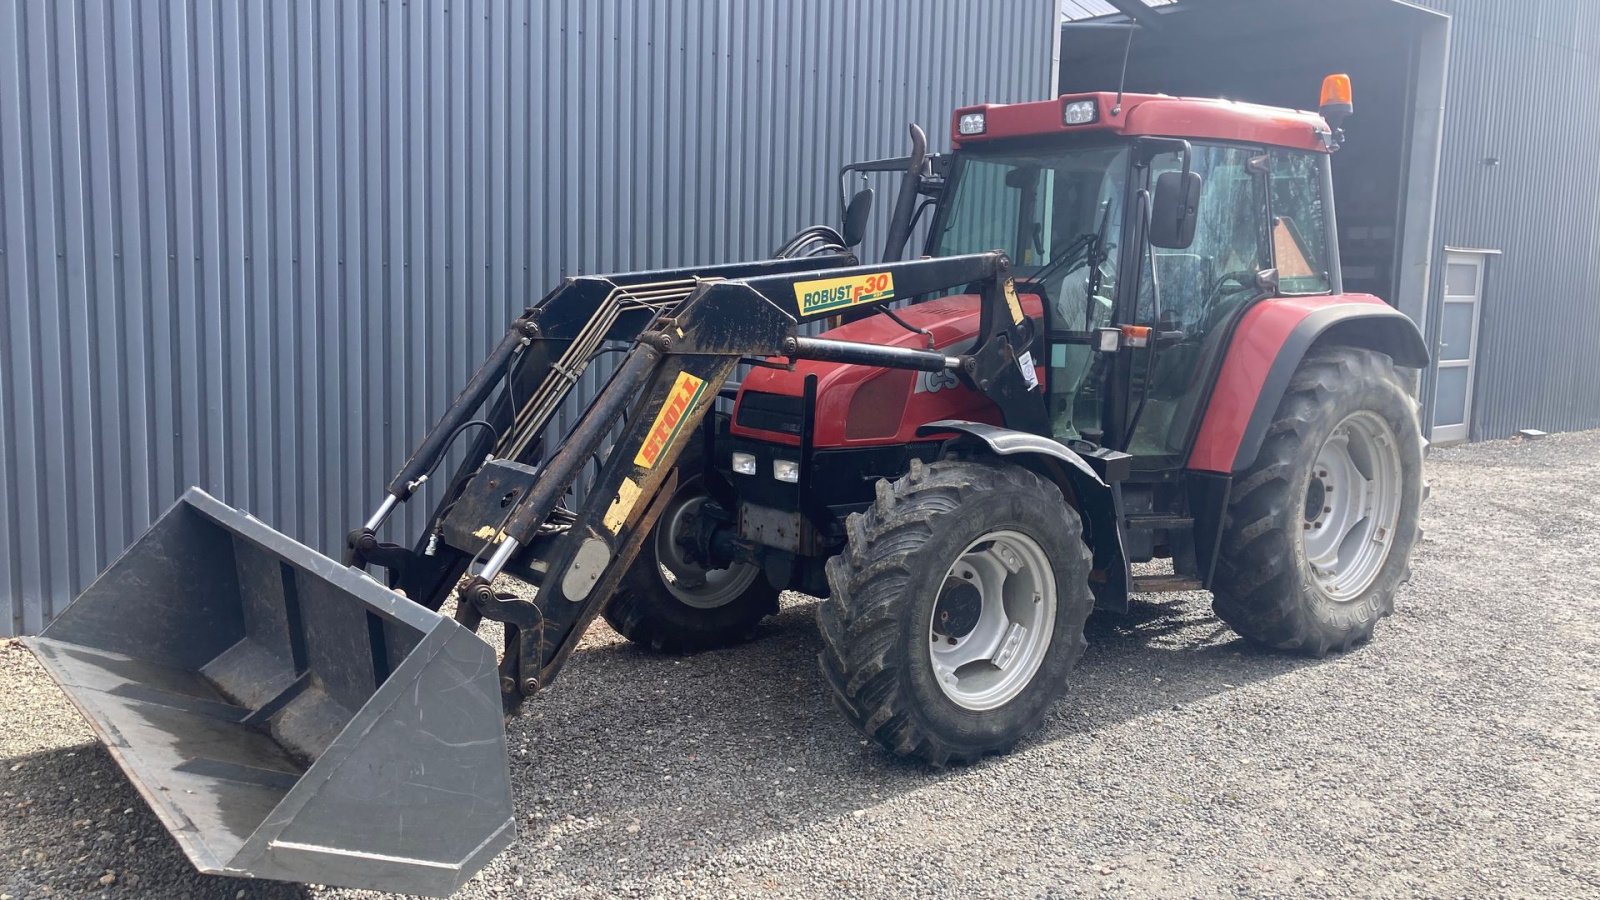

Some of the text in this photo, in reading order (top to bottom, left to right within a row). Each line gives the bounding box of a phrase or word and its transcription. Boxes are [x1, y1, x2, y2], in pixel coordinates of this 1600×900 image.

[803, 274, 888, 308] ROBUST F30
[641, 376, 700, 465] STOLL
